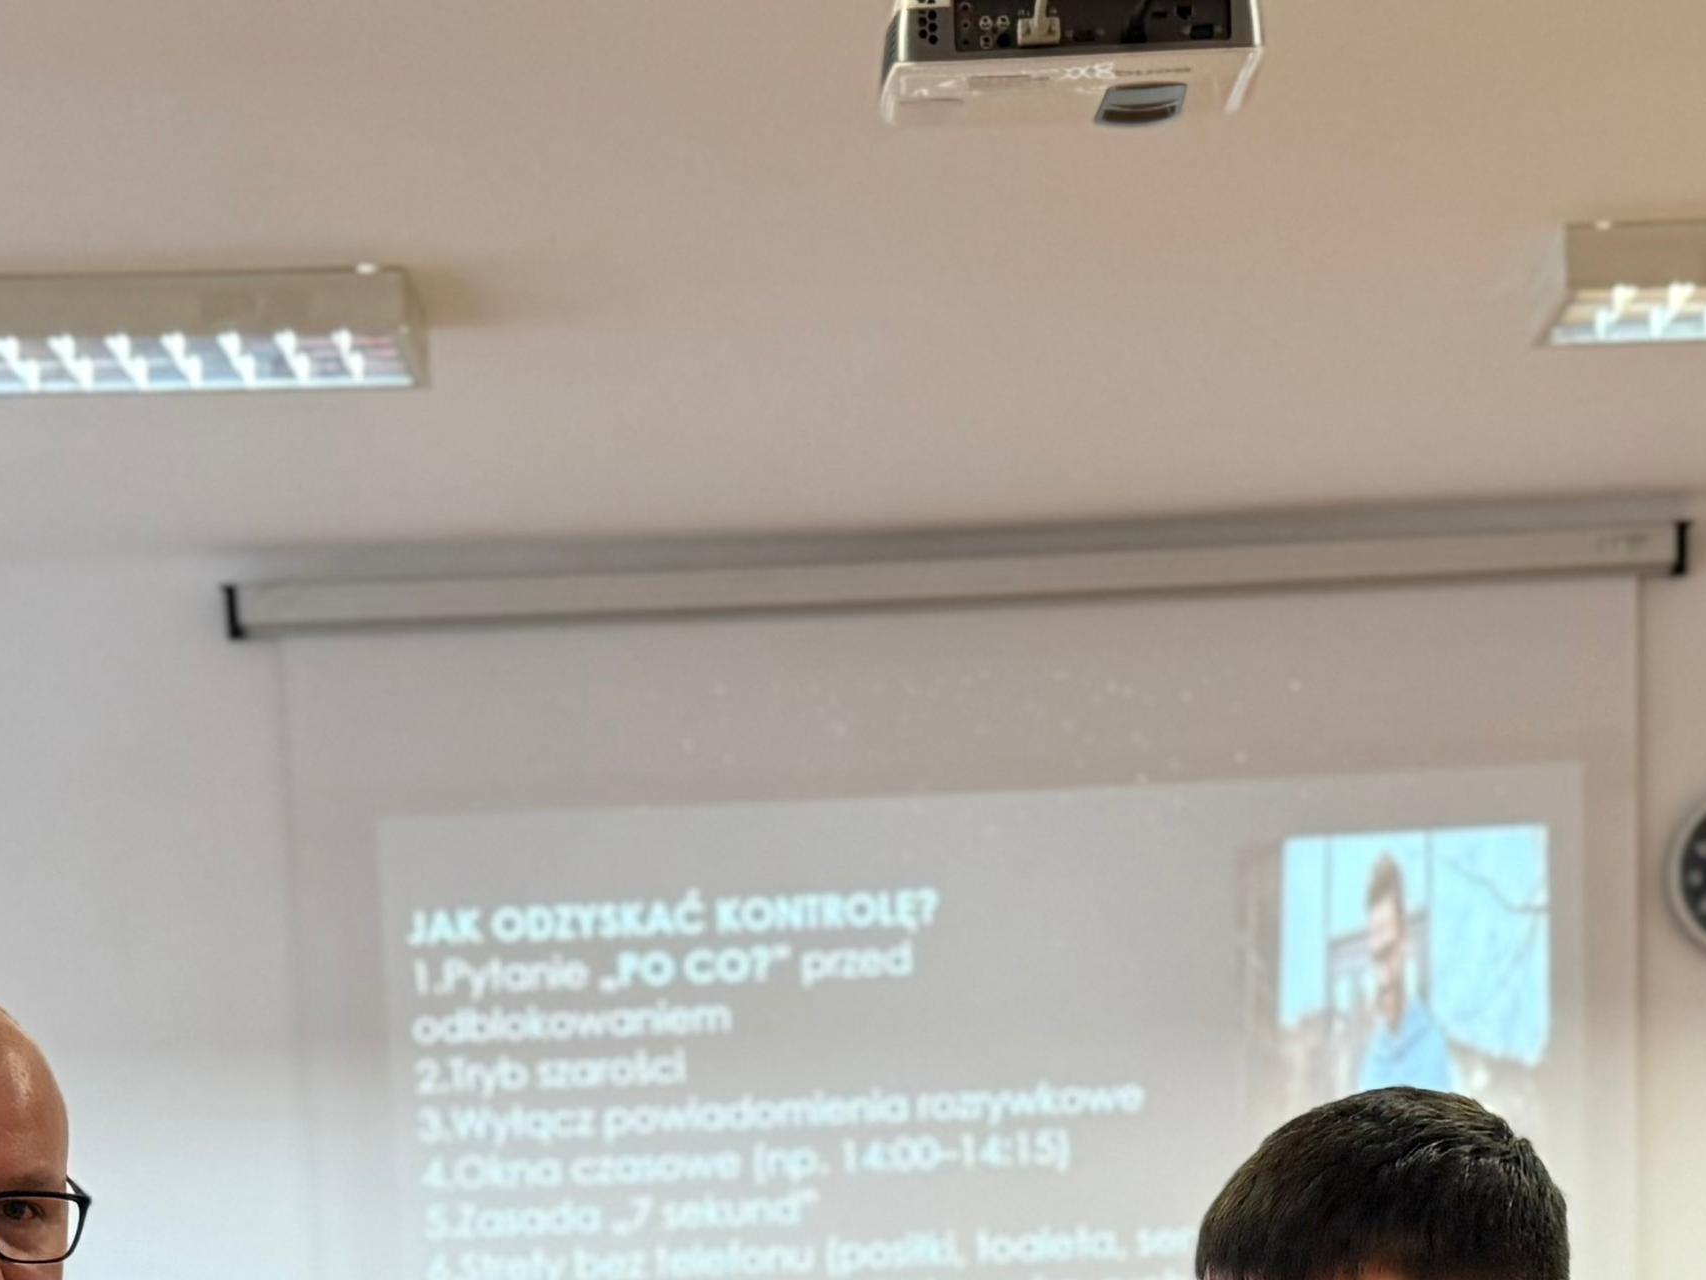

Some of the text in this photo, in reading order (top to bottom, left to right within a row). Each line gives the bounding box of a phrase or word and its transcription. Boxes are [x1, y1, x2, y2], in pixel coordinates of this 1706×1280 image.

[408, 887, 937, 944] JAK ODZYSKAĆ KONTROLĘ?
[803, 941, 911, 987] przed
[413, 1001, 730, 1044] odblokowaniem
[538, 1048, 684, 1087] szarości
[605, 1086, 908, 1143] powiadomienia
[918, 1080, 1143, 1123] rozrywkowe
[572, 1152, 740, 1184] czasowe
[575, 1246, 645, 1280] bez
[659, 1239, 813, 1276] telefonu
[978, 1225, 1125, 1263] toaleta,
